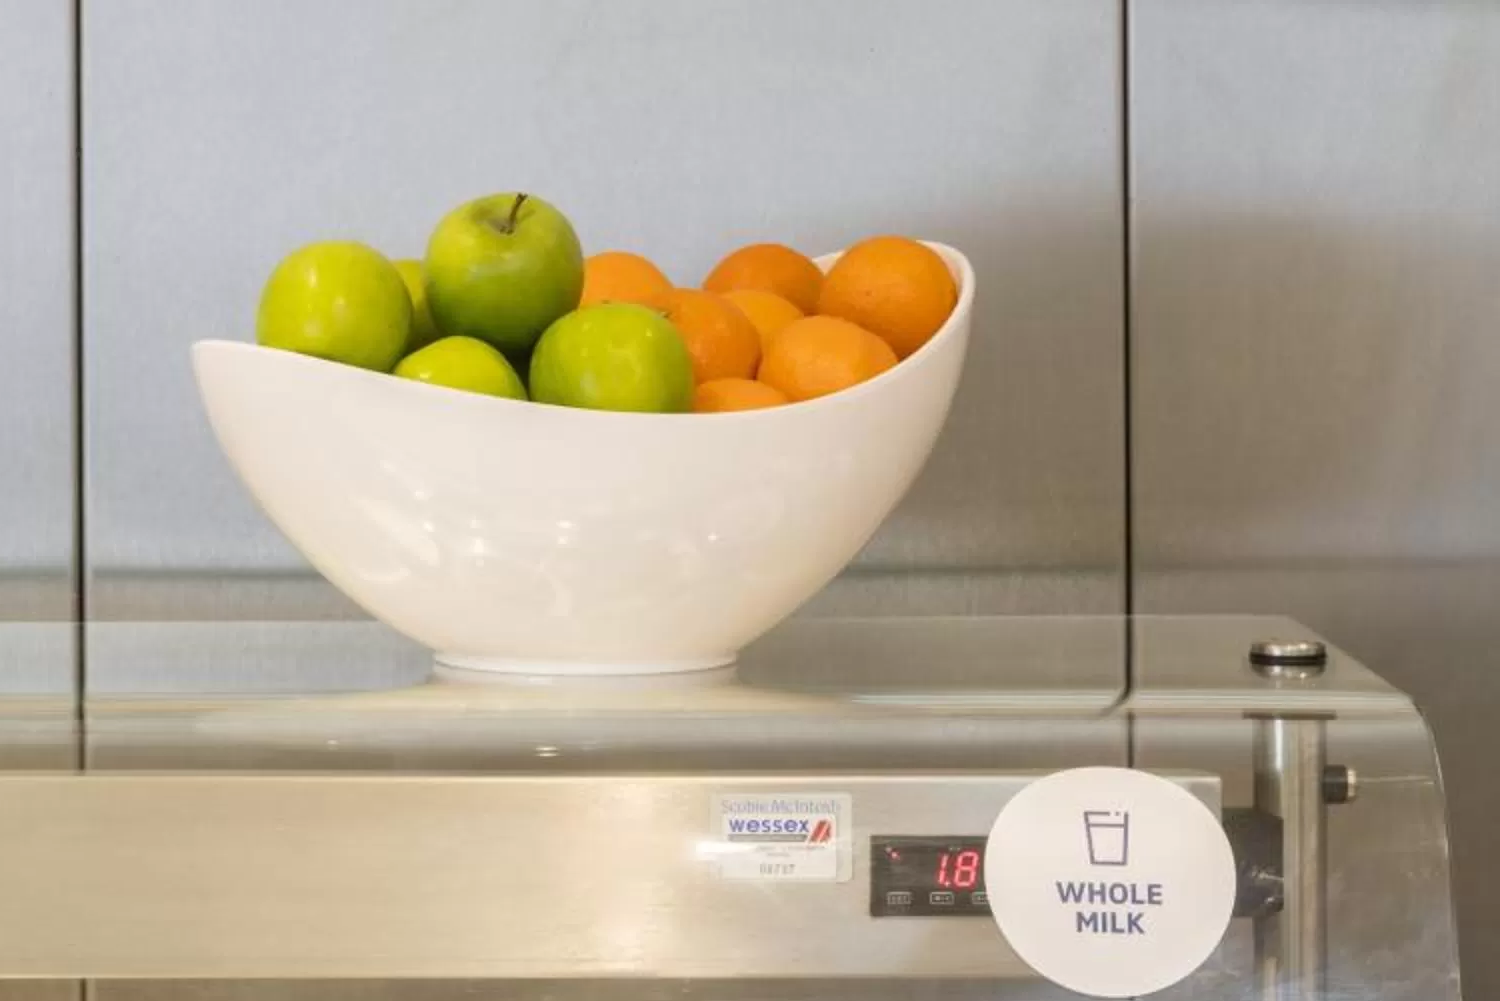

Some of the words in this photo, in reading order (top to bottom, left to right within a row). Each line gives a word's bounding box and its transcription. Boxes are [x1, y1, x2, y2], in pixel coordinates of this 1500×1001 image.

[728, 819, 810, 833] wessex
[938, 850, 979, 888] 1.8
[1056, 881, 1163, 906] WHOLE
[1076, 911, 1145, 935] MILK
